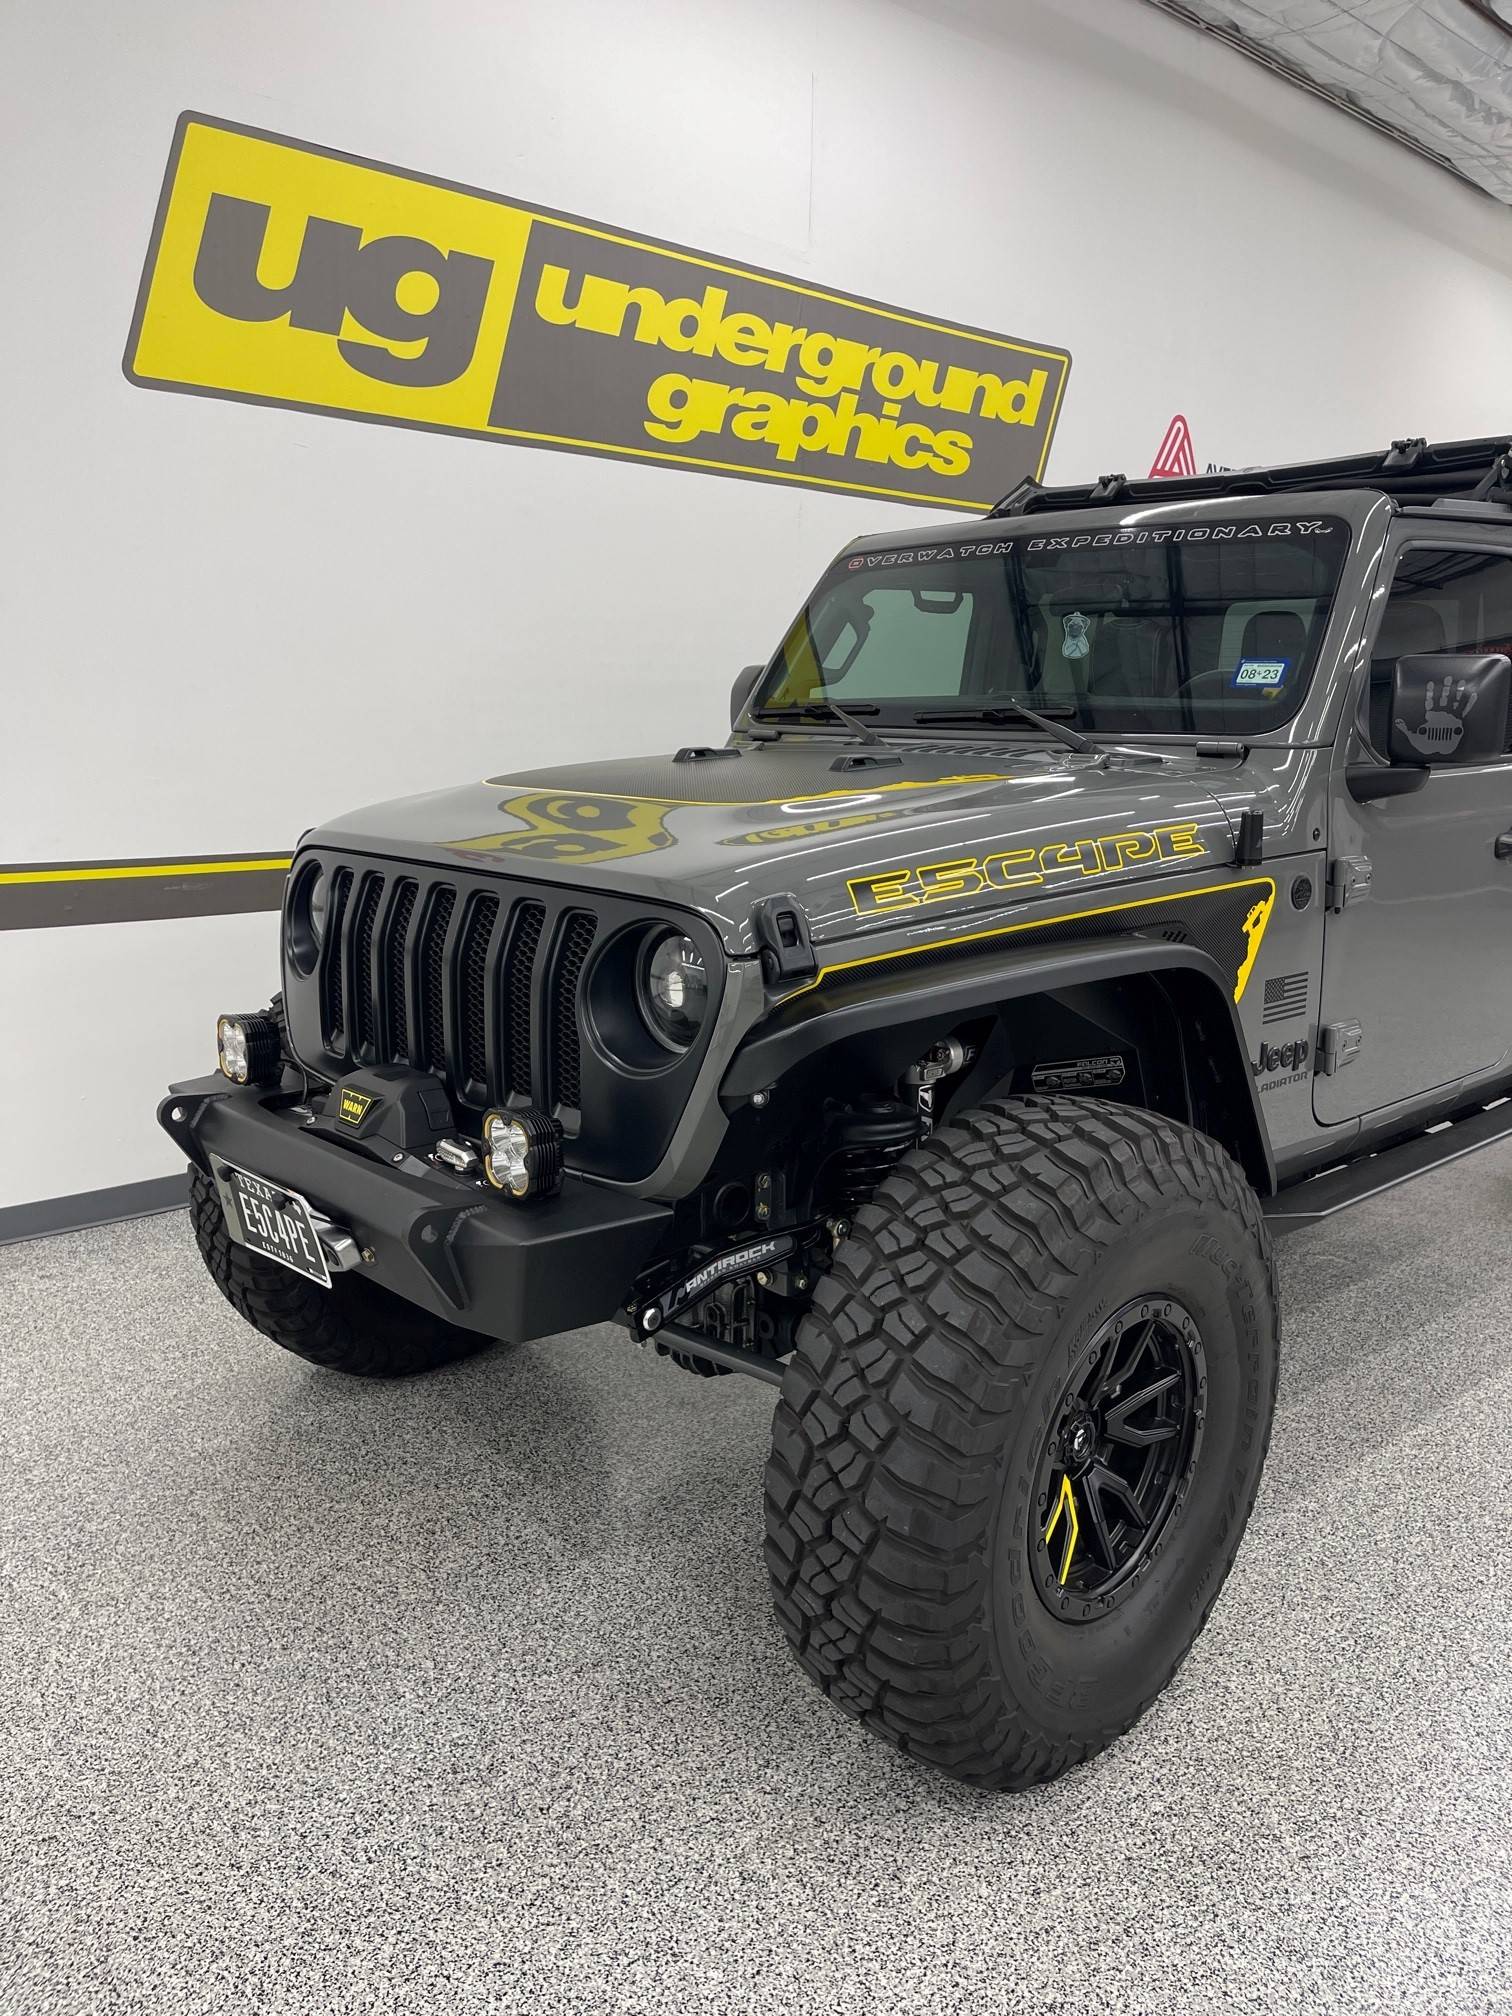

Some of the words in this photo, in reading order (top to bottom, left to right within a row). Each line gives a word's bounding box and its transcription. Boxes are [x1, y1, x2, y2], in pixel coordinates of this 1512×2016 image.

[193, 192, 495, 388] ug
[534, 264, 1048, 426] underground
[643, 372, 973, 477] graphics
[848, 542, 1014, 570] OVERWATCH
[1027, 521, 1323, 551] EXPEDITIONARY
[1261, 669, 1279, 680] 23
[1250, 1039, 1309, 1077] Jeep
[343, 1098, 363, 1116] WARN
[234, 1171, 277, 1202] TEXA
[238, 1191, 316, 1263] E5C4PE
[685, 1241, 776, 1293] ANTIROCK
